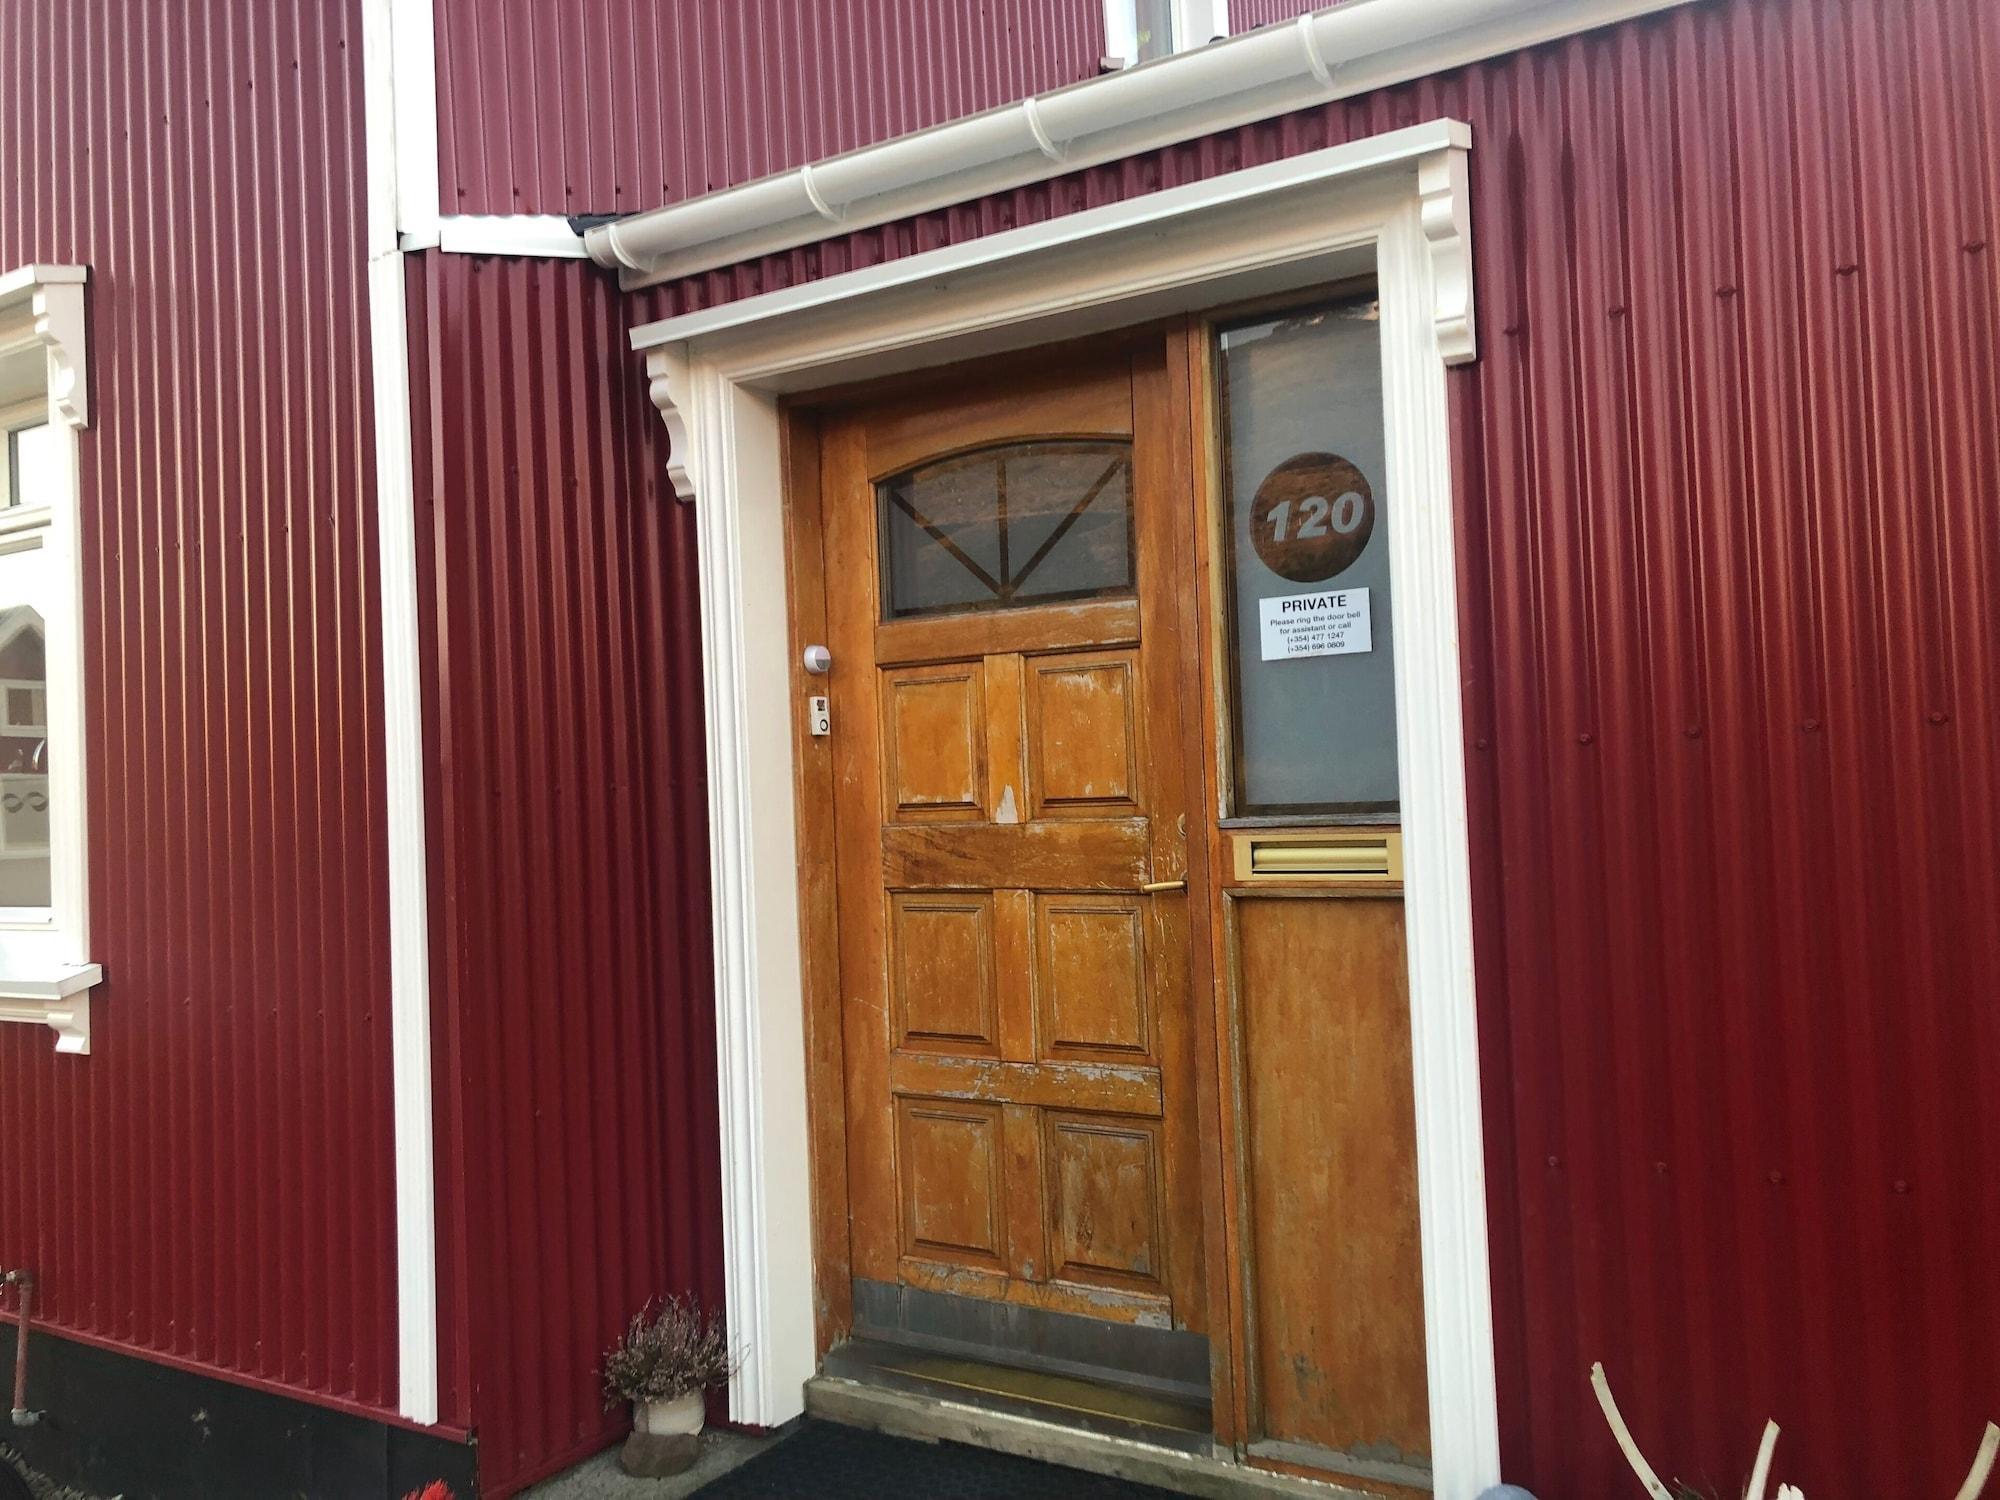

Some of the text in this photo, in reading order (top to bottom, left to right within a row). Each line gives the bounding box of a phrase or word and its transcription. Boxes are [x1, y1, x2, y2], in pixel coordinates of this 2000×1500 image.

[1266, 491, 1364, 541] 120
[1282, 595, 1347, 613] PRIVATE
[1270, 610, 1361, 626] Please ring the door bell
[1292, 624, 1326, 634] assistant
[1338, 621, 1352, 629] call
[1287, 631, 1345, 644] (+354) 477 1247
[1287, 645, 1310, 654] (+354)
[1311, 642, 1325, 650] 696
